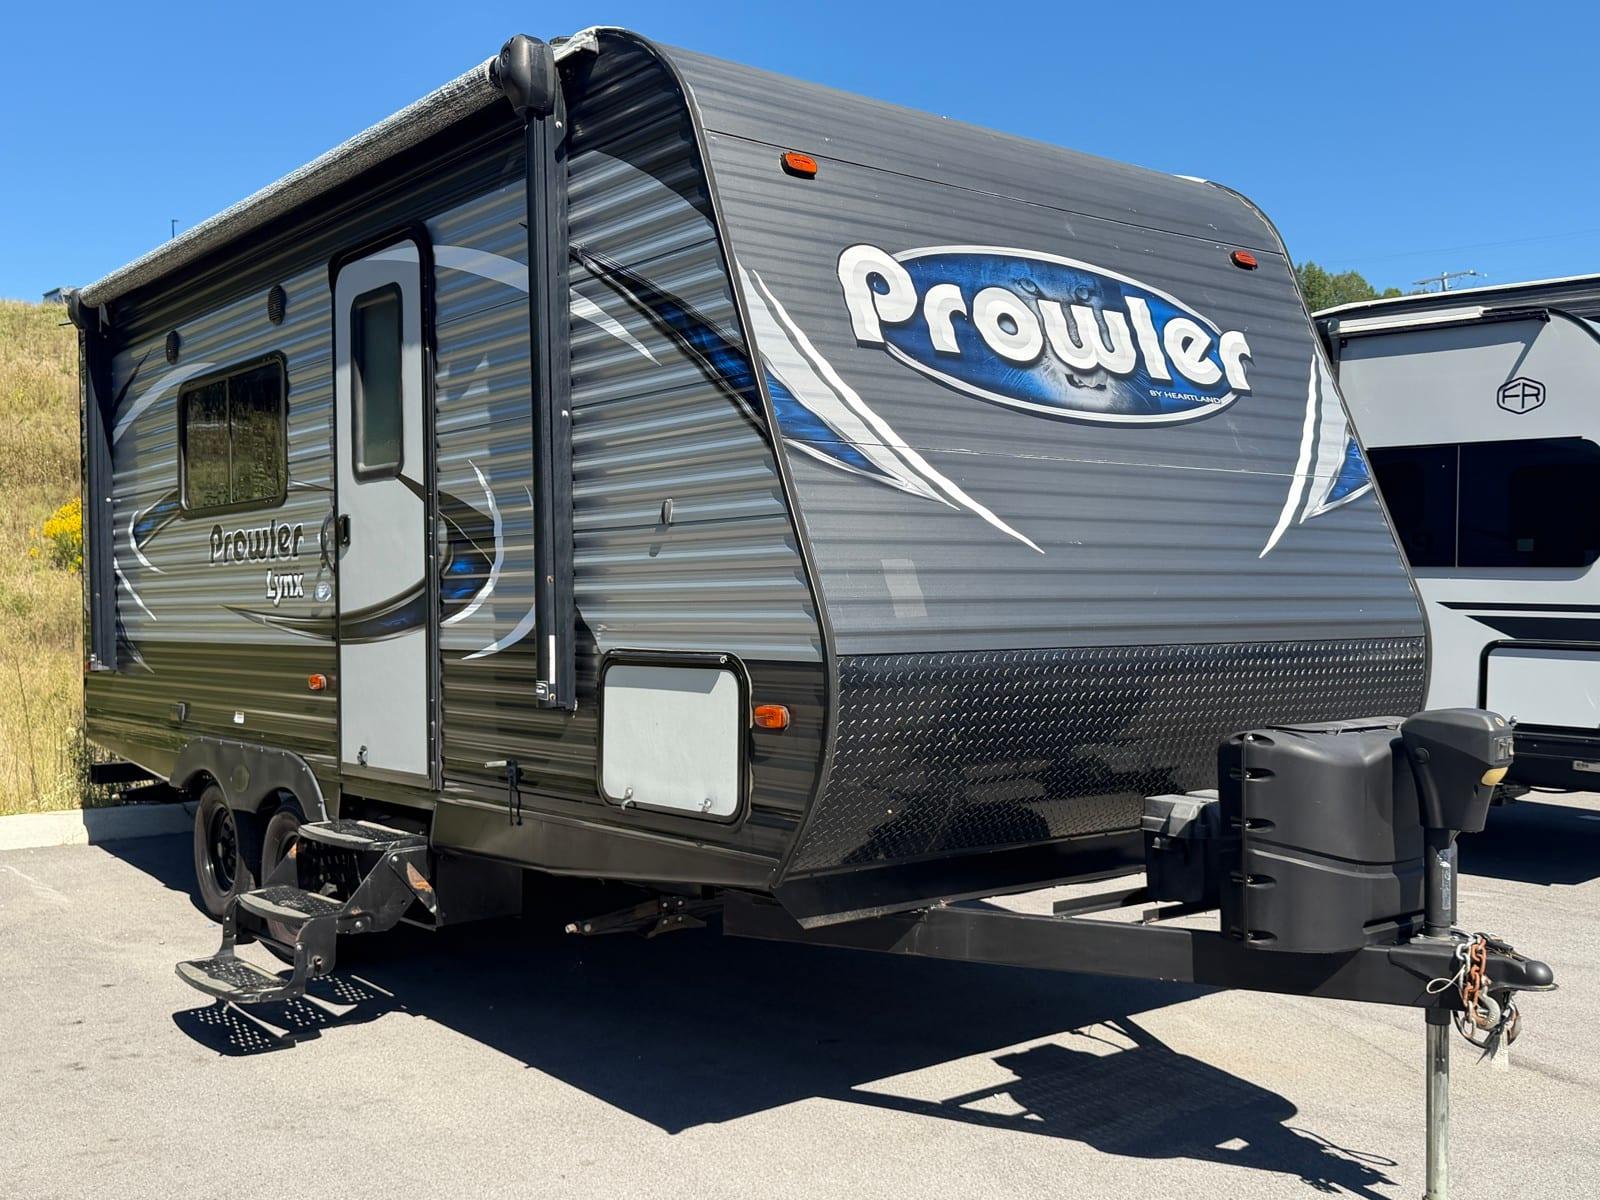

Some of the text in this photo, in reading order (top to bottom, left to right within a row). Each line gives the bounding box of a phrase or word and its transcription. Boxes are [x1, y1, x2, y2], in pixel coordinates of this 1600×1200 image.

[837, 242, 1255, 395] Prowler
[1149, 389, 1221, 405] BY HEARTLAND
[209, 519, 304, 566] Prowler
[266, 568, 304, 607] Lynx
